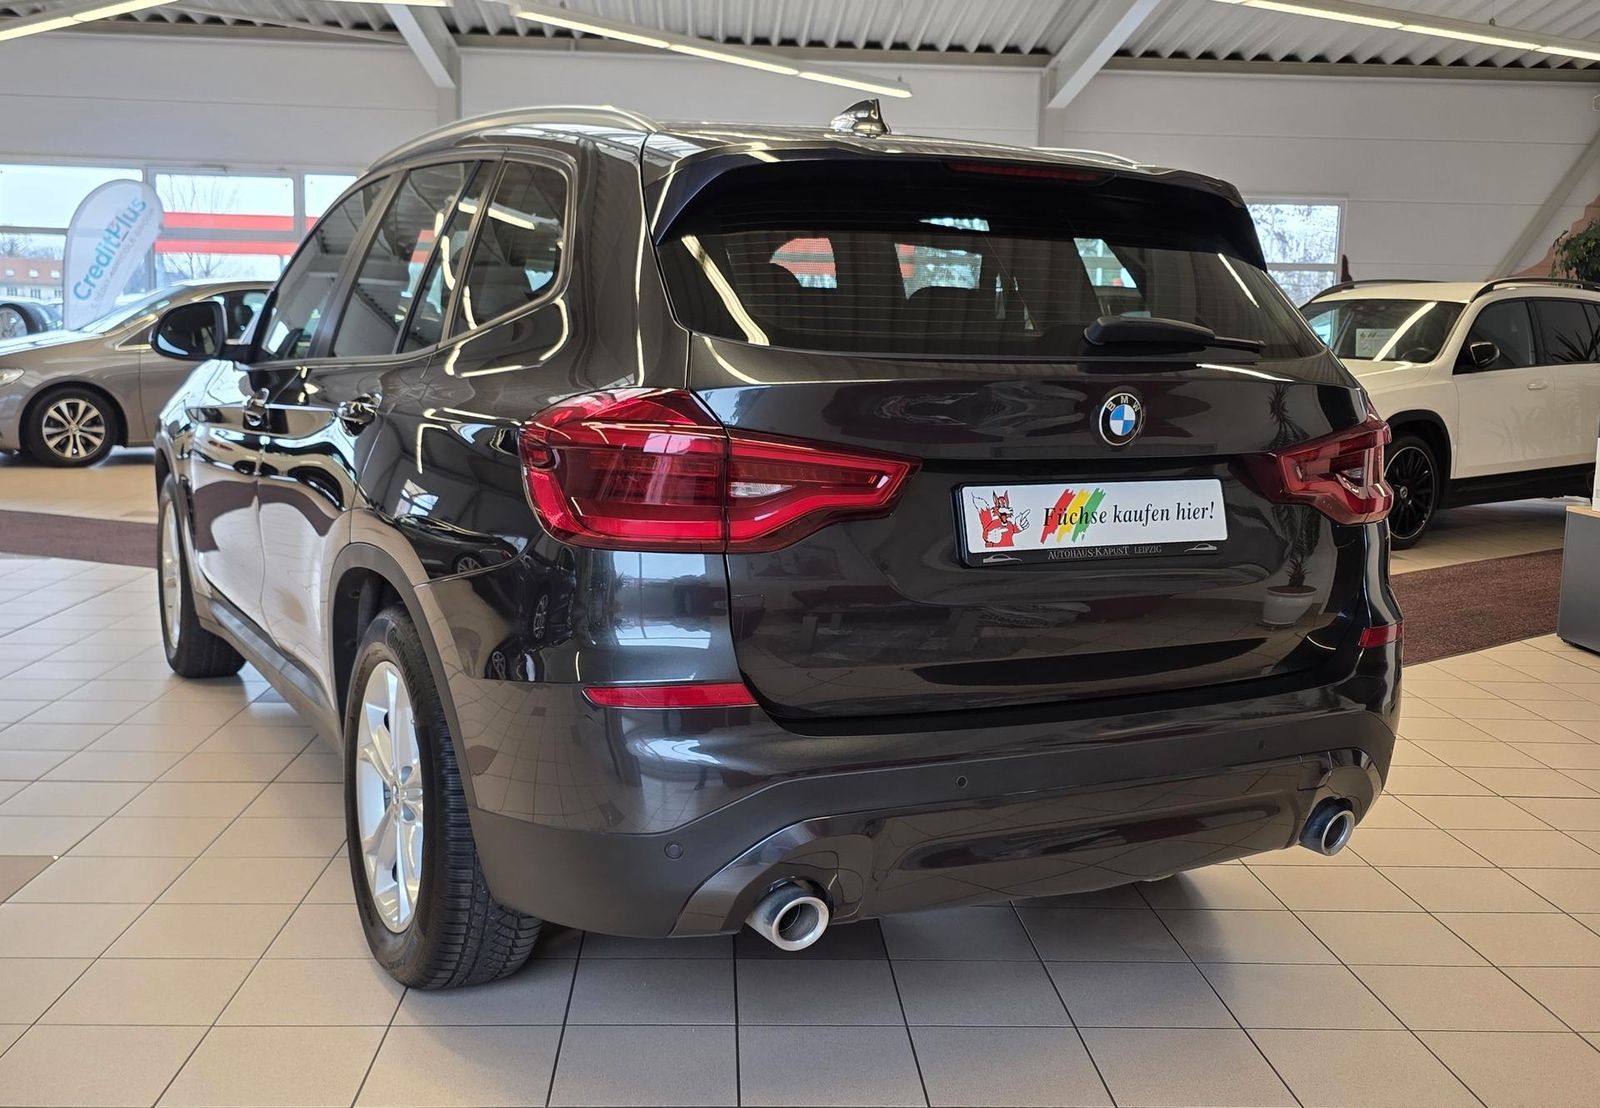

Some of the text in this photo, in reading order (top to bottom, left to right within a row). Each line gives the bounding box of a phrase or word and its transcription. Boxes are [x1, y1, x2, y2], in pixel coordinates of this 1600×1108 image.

[73, 197, 147, 301] CreditPlus
[1106, 395, 1141, 412] BMW
[1043, 501, 1214, 527] Füchse kaufen hier!
[1134, 545, 1162, 554] LEIPZIG
